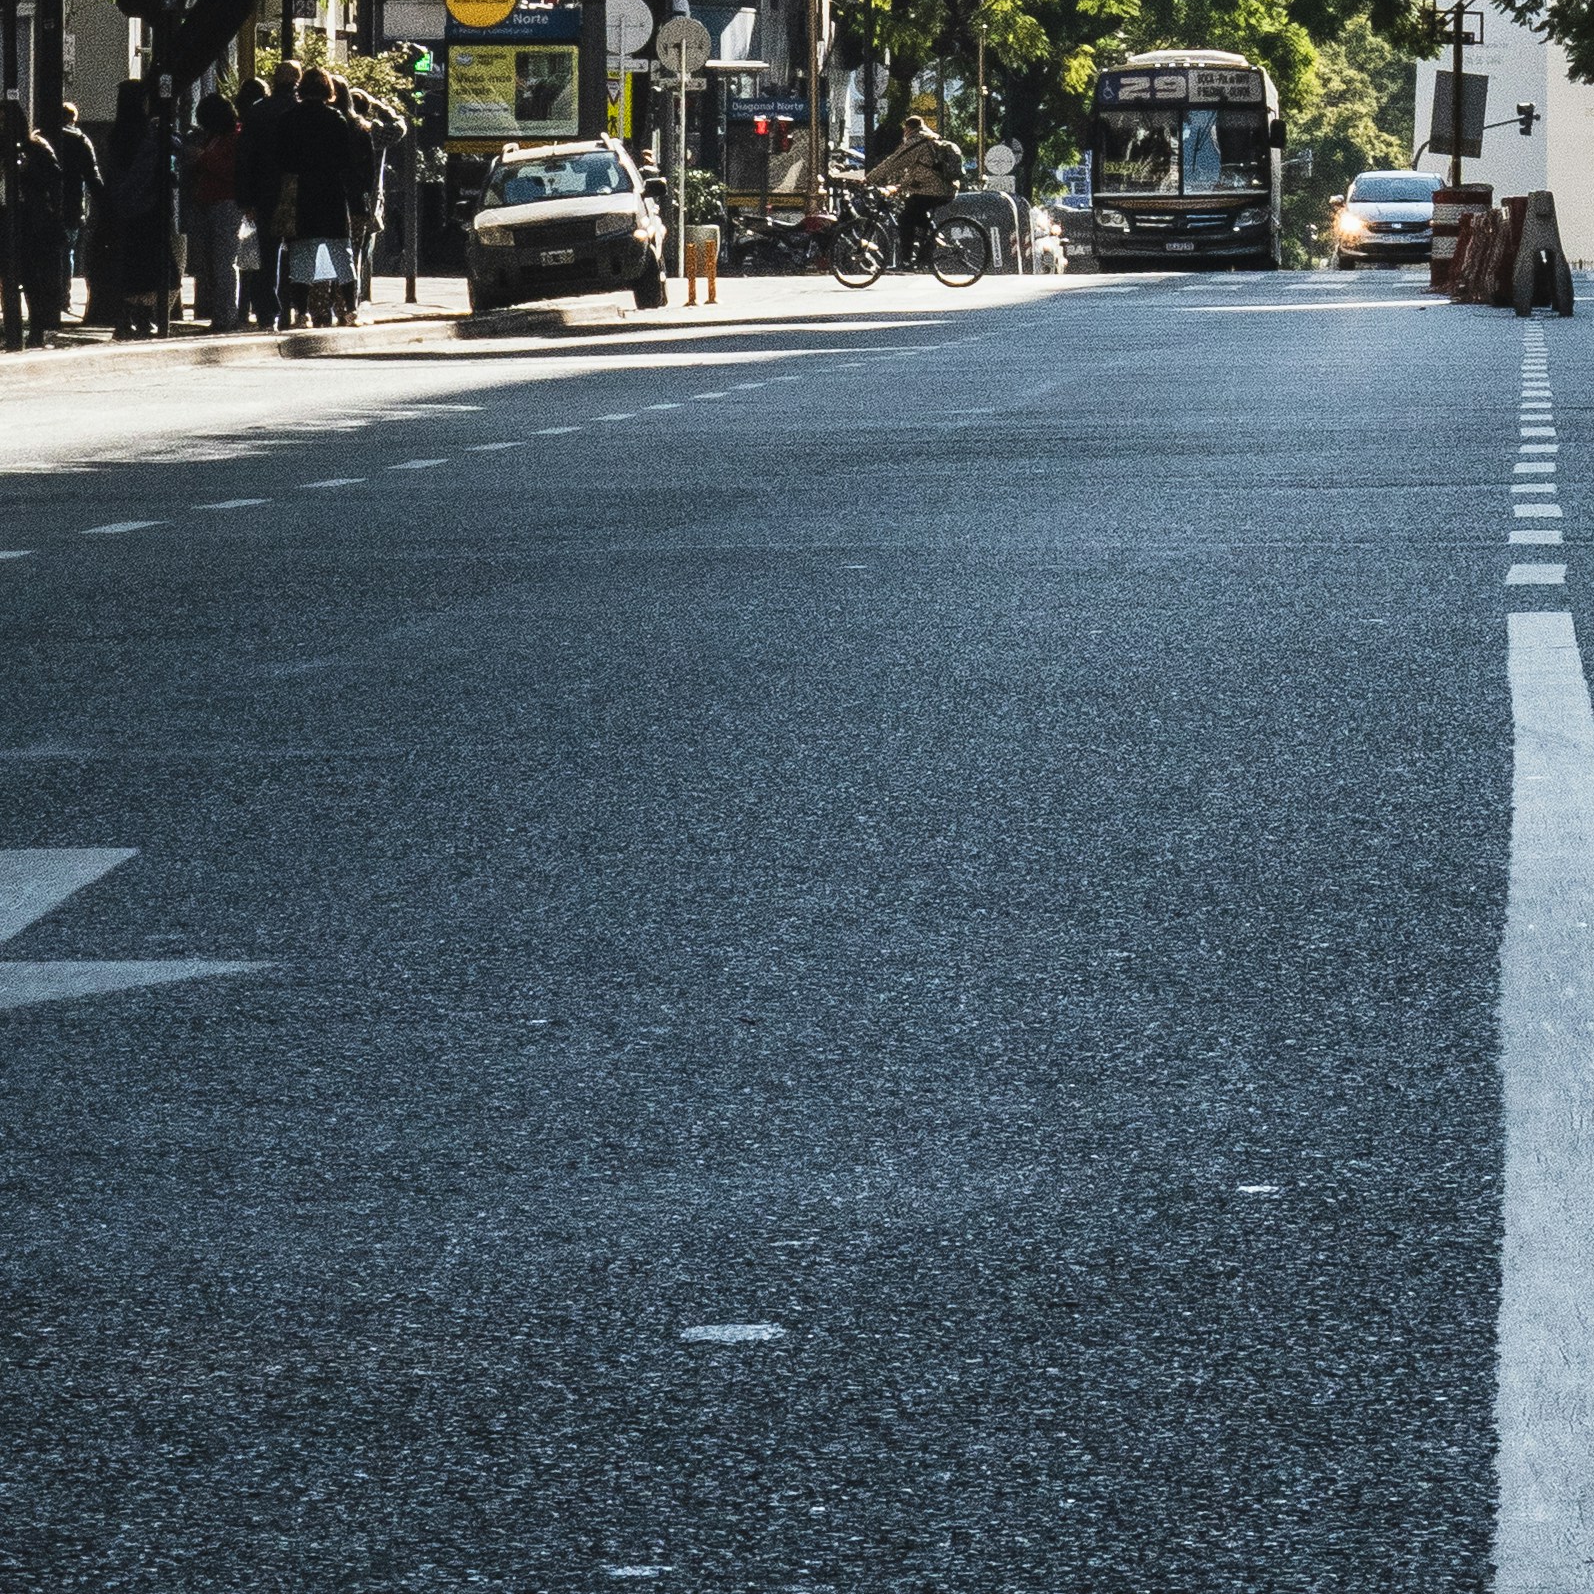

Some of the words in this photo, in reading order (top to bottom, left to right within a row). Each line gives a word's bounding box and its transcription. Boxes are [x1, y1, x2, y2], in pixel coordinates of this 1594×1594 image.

[513, 14, 549, 24] Norte
[1118, 76, 1187, 101] 29
[732, 102, 774, 113] Diagonal
[777, 102, 804, 111] Norte
